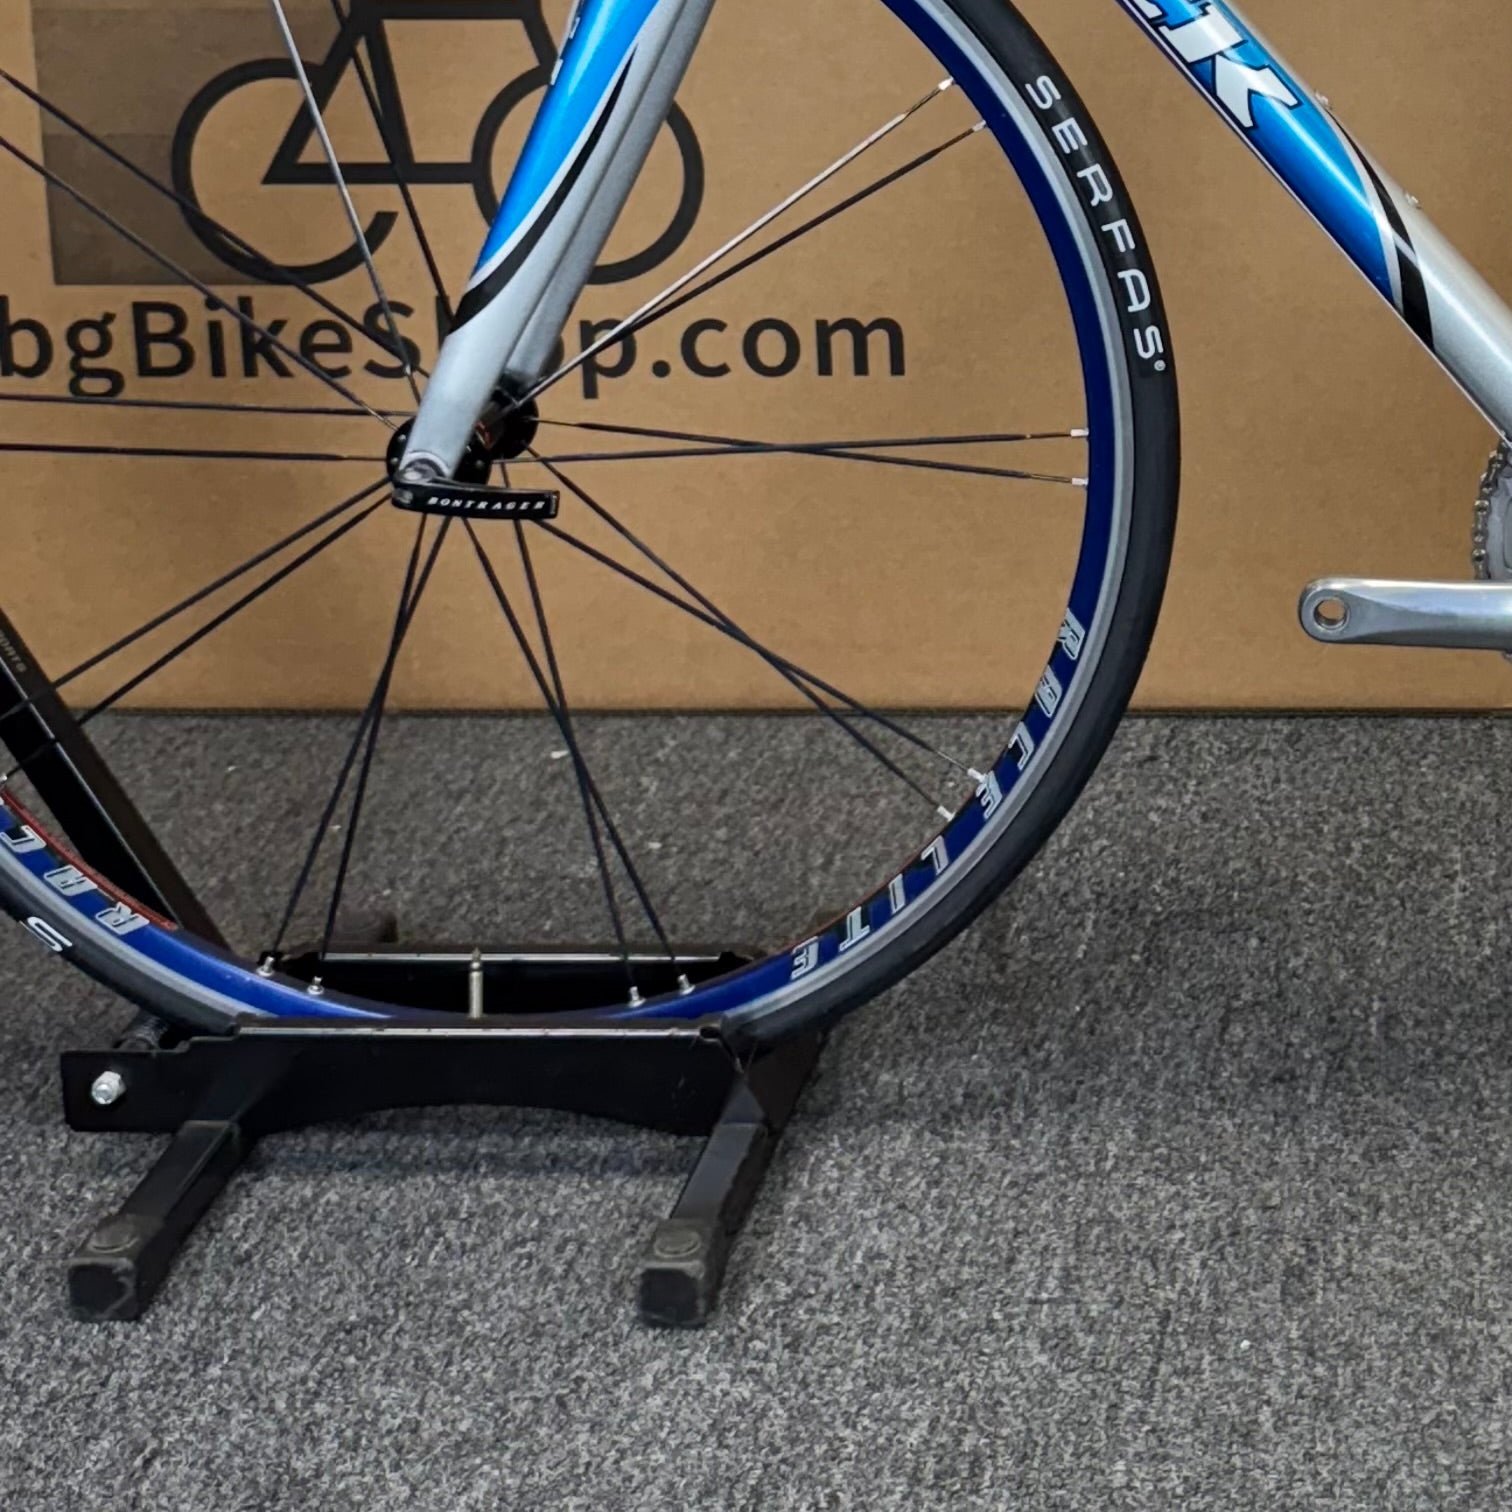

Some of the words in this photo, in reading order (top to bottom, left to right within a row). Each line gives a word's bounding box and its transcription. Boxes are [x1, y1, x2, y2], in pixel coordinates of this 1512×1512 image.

[1025, 74, 1167, 360] SERFAS
[427, 496, 546, 511] BONTRAGER
[975, 607, 1087, 819] RACE
[0, 796, 150, 936] RAC
[790, 834, 950, 981] LITE
